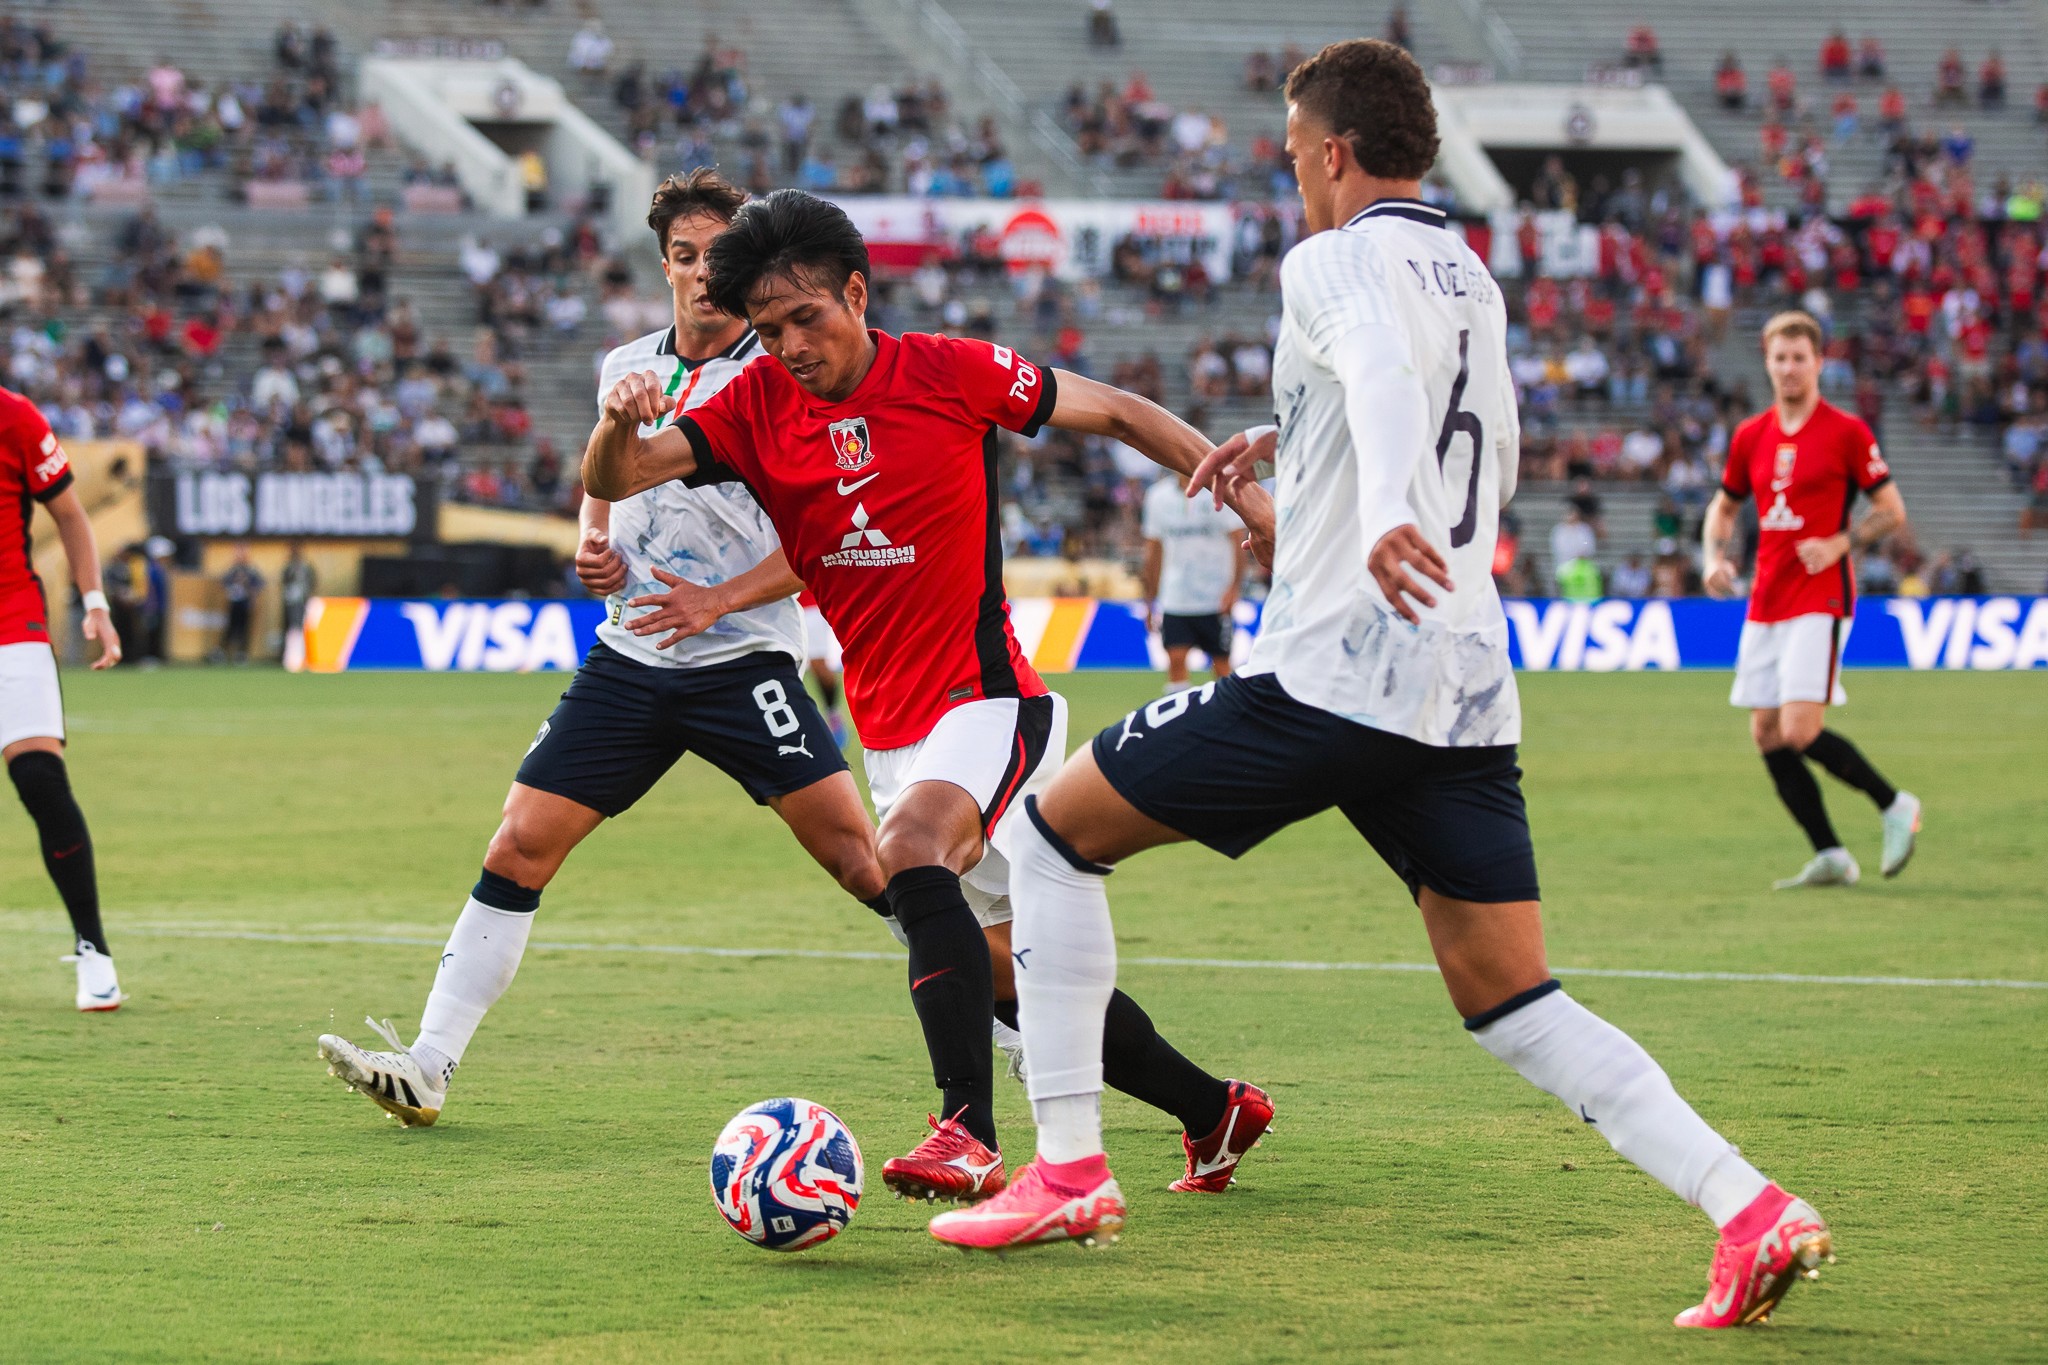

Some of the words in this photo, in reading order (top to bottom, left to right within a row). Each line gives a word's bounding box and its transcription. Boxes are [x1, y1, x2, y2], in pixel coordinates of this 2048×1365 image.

[1435, 328, 1483, 548] 6
[175, 470, 251, 535] LOS
[254, 470, 417, 536] ANGELES
[821, 545, 915, 563] MITSUBISHI
[823, 559, 853, 568] HEAVY
[855, 556, 915, 567] INDUSTRIES
[403, 601, 580, 671] VISA
[1505, 600, 1682, 672] VISA
[1888, 598, 2048, 671] VISA
[752, 679, 800, 738] 8
[1145, 681, 1216, 729] 6
